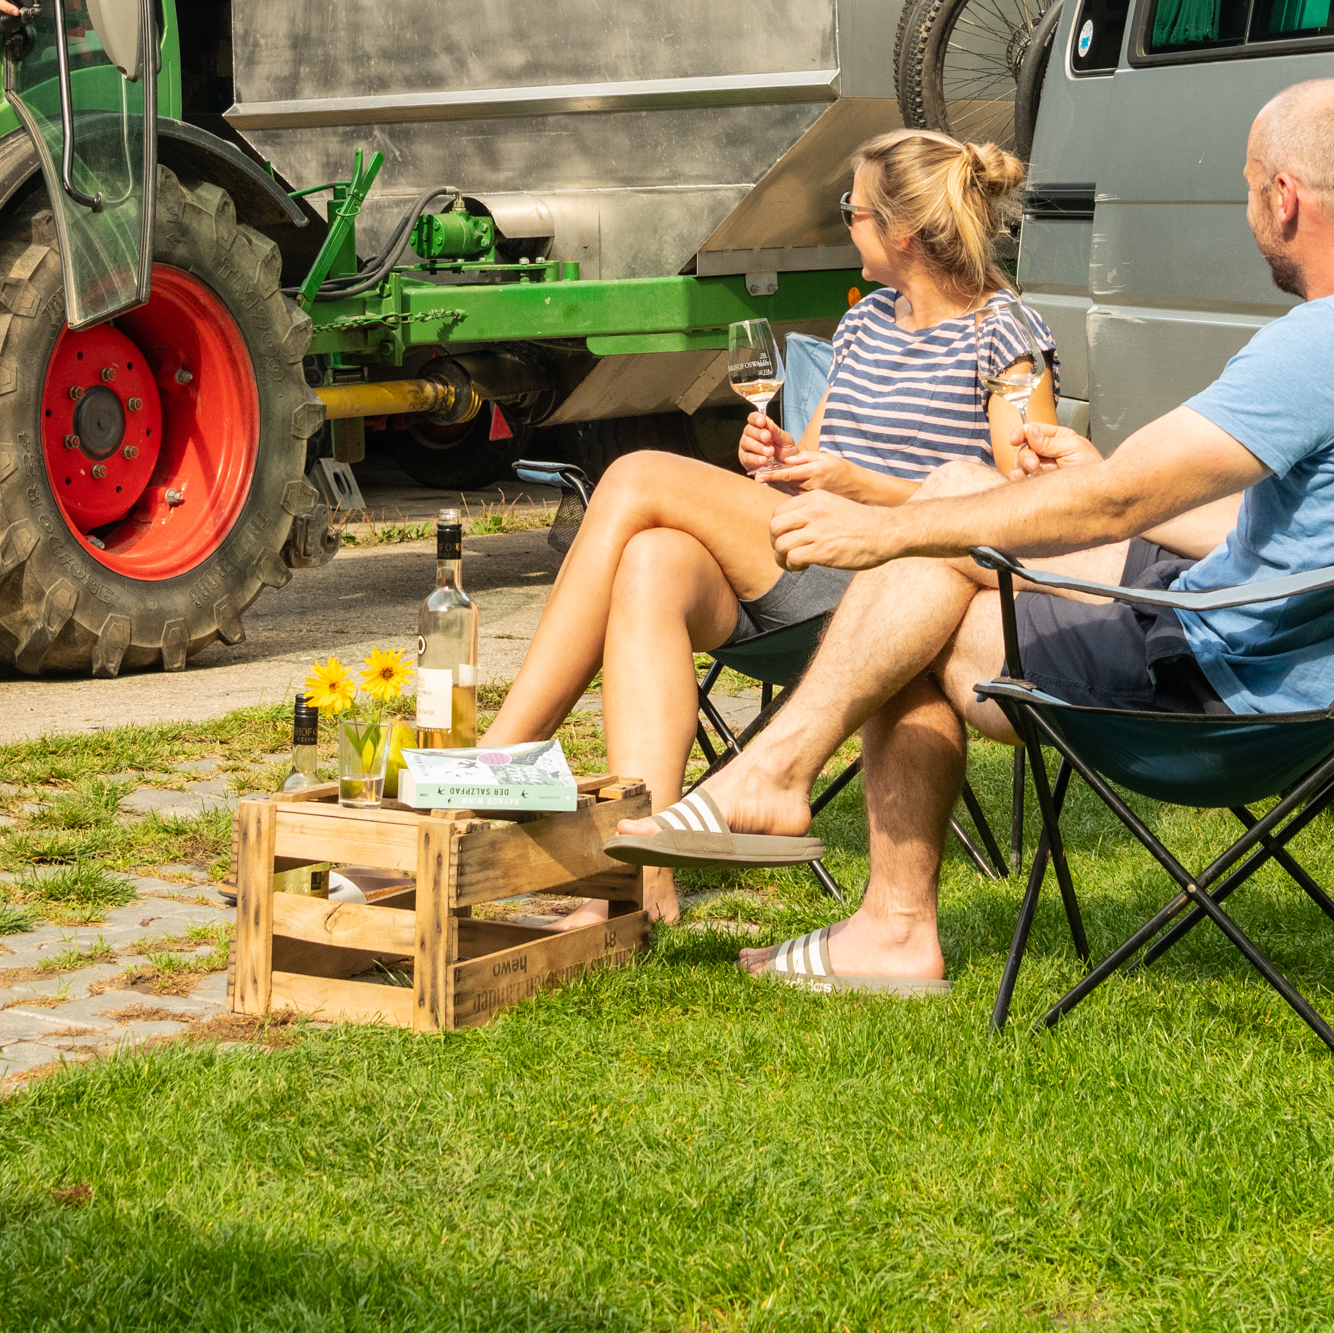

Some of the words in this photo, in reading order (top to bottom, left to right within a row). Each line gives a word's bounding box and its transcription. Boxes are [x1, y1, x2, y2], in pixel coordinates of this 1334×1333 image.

[187, 510, 274, 609] TRELLEBORG
[449, 787, 491, 796] SALZPFAD
[493, 788, 509, 796] DER
[462, 796, 484, 805] WINN
[486, 796, 520, 806] RAYNOR
[604, 931, 617, 950] 81
[492, 954, 528, 977] hewo
